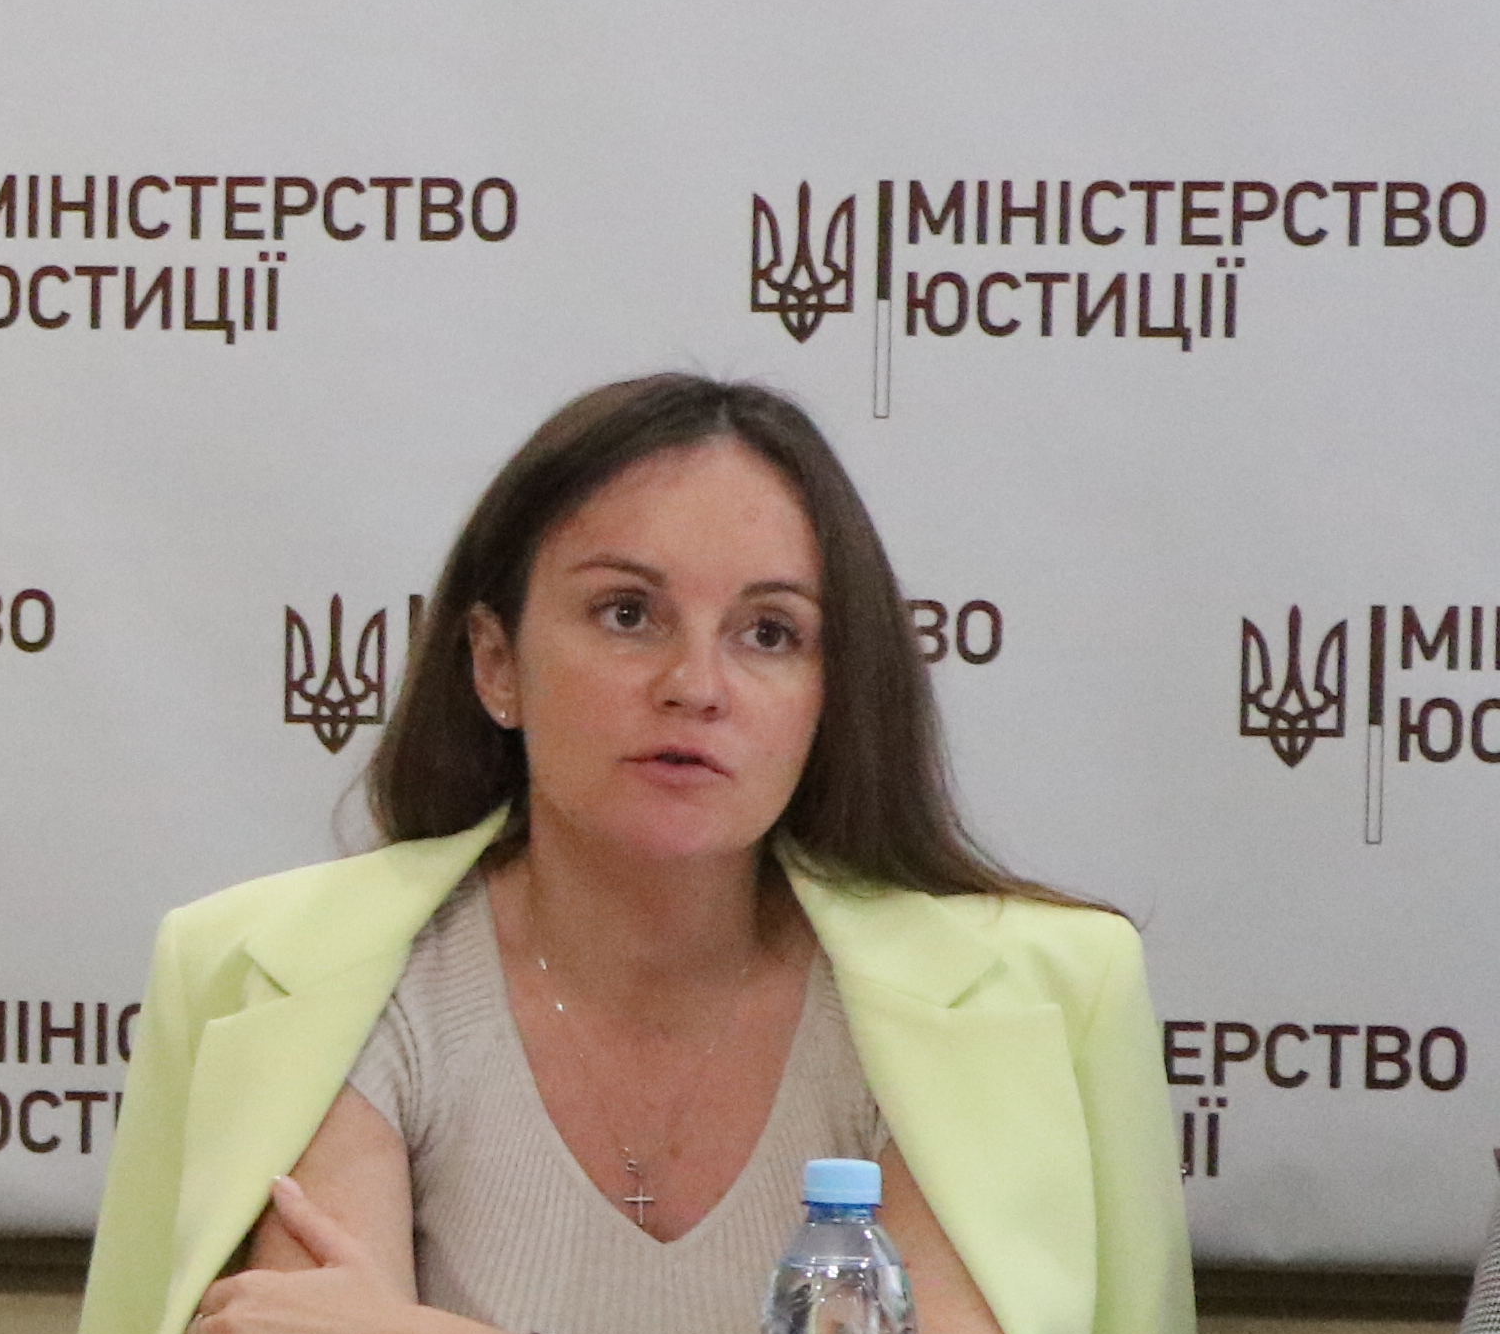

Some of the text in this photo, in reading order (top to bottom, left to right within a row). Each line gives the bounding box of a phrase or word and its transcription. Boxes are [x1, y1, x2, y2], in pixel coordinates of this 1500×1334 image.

[907, 179, 1487, 248] МІНІСТЕРСТВО
[905, 256, 1246, 353] ЮСТИЦІЇ
[1162, 1020, 1468, 1091] ЕРСТВО
